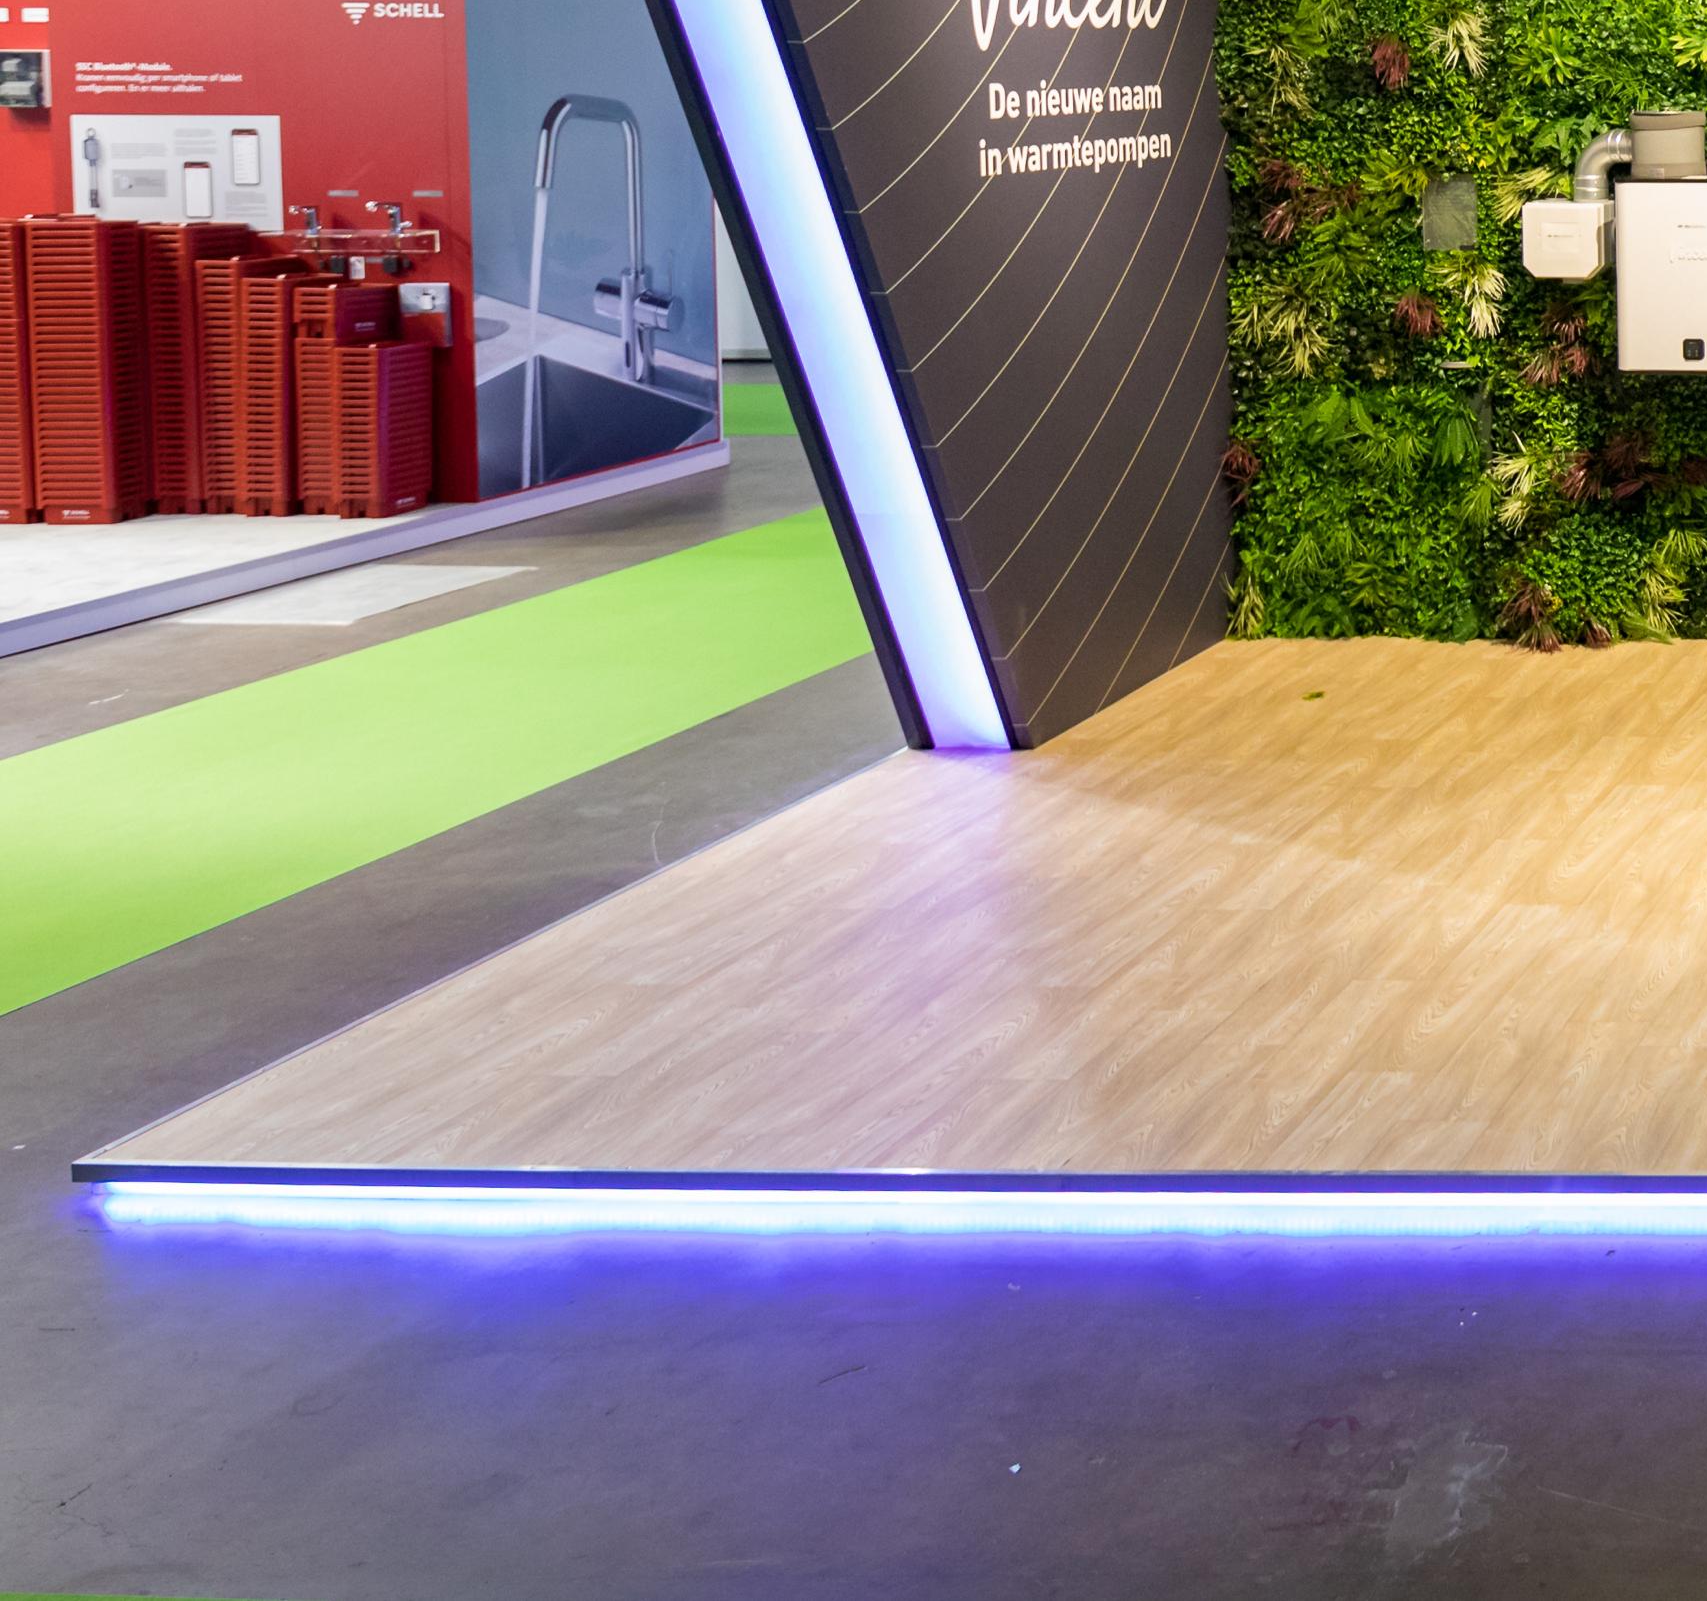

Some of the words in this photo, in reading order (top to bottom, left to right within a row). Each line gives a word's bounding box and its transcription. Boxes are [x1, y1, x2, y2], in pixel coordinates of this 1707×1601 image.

[373, 2, 445, 19] SCHELL
[988, 82, 1021, 120] De
[1026, 79, 1104, 118] nieuwe
[1109, 81, 1163, 113] naam
[979, 139, 1003, 178] in
[1006, 131, 1172, 176] warmtepompen
